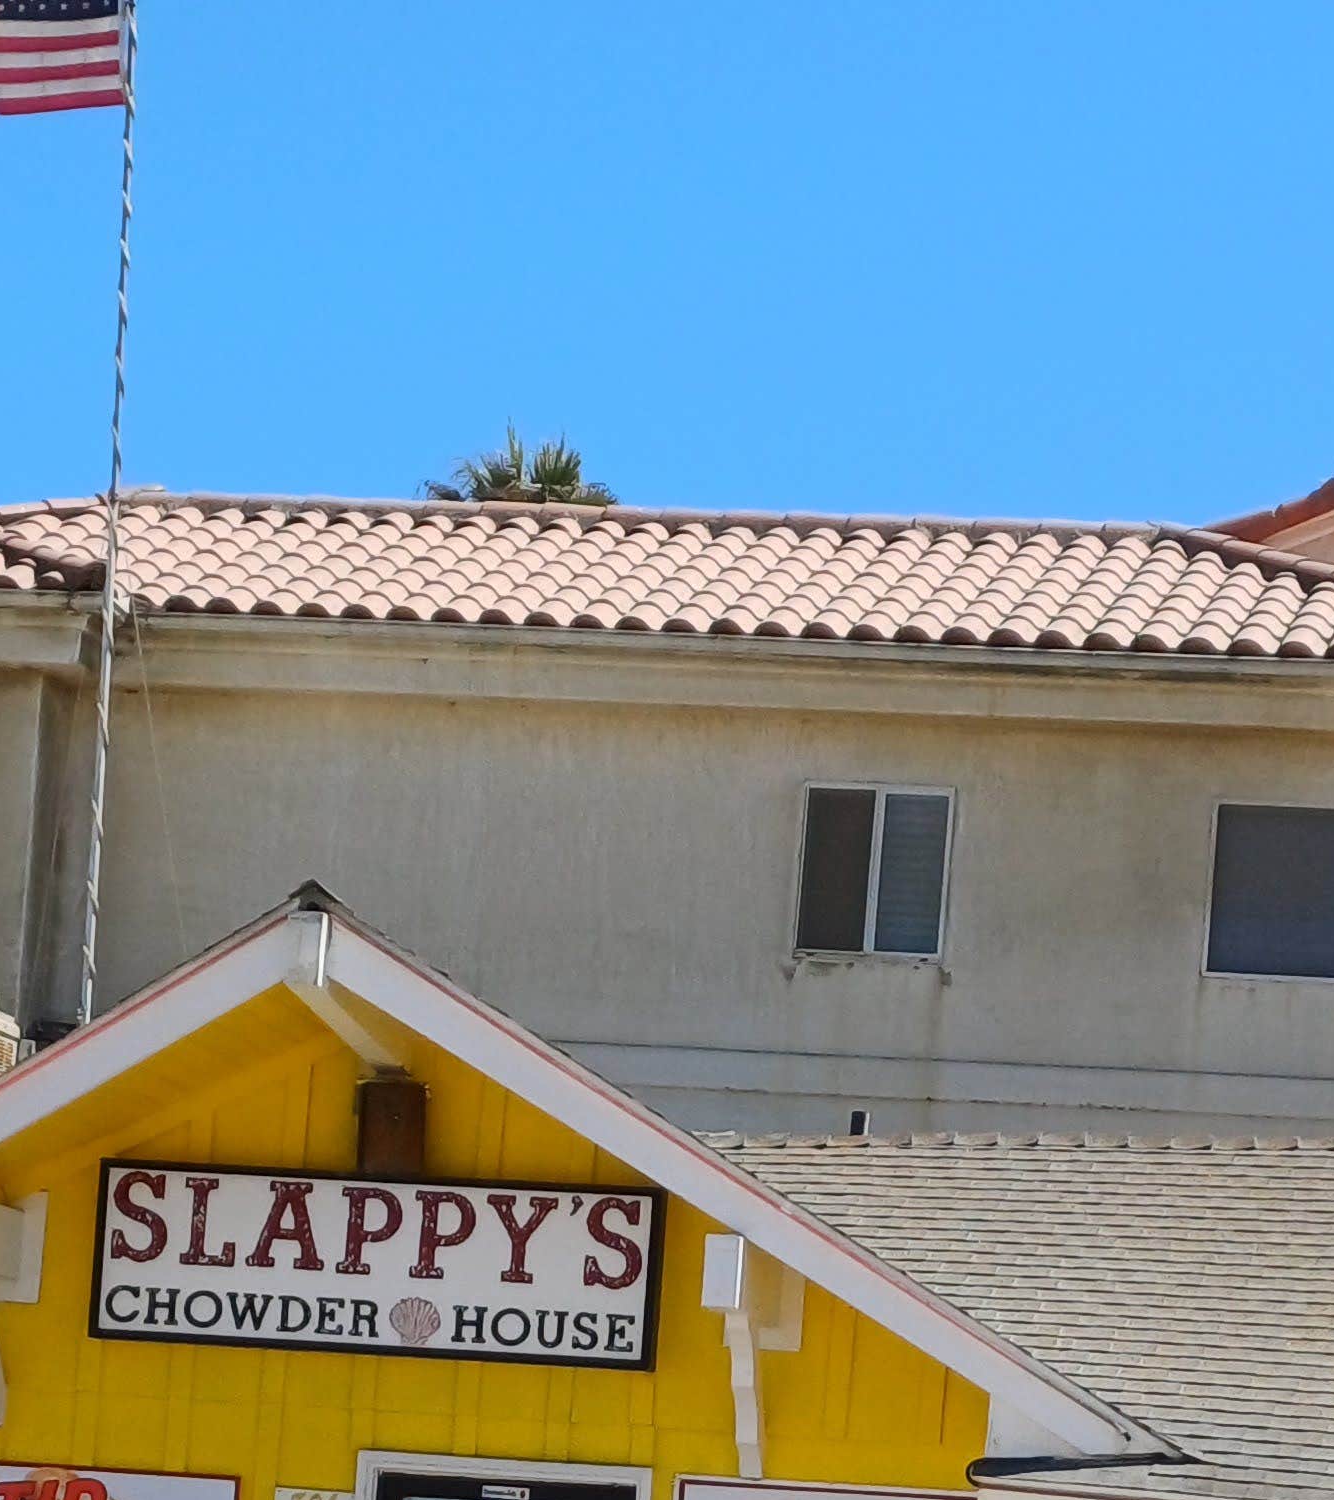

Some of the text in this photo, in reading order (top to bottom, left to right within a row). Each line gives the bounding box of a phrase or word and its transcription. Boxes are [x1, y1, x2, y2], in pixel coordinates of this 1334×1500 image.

[110, 1170, 643, 1290] SLAPPY'S
[104, 1284, 636, 1353] CHOWDER HOUSE
